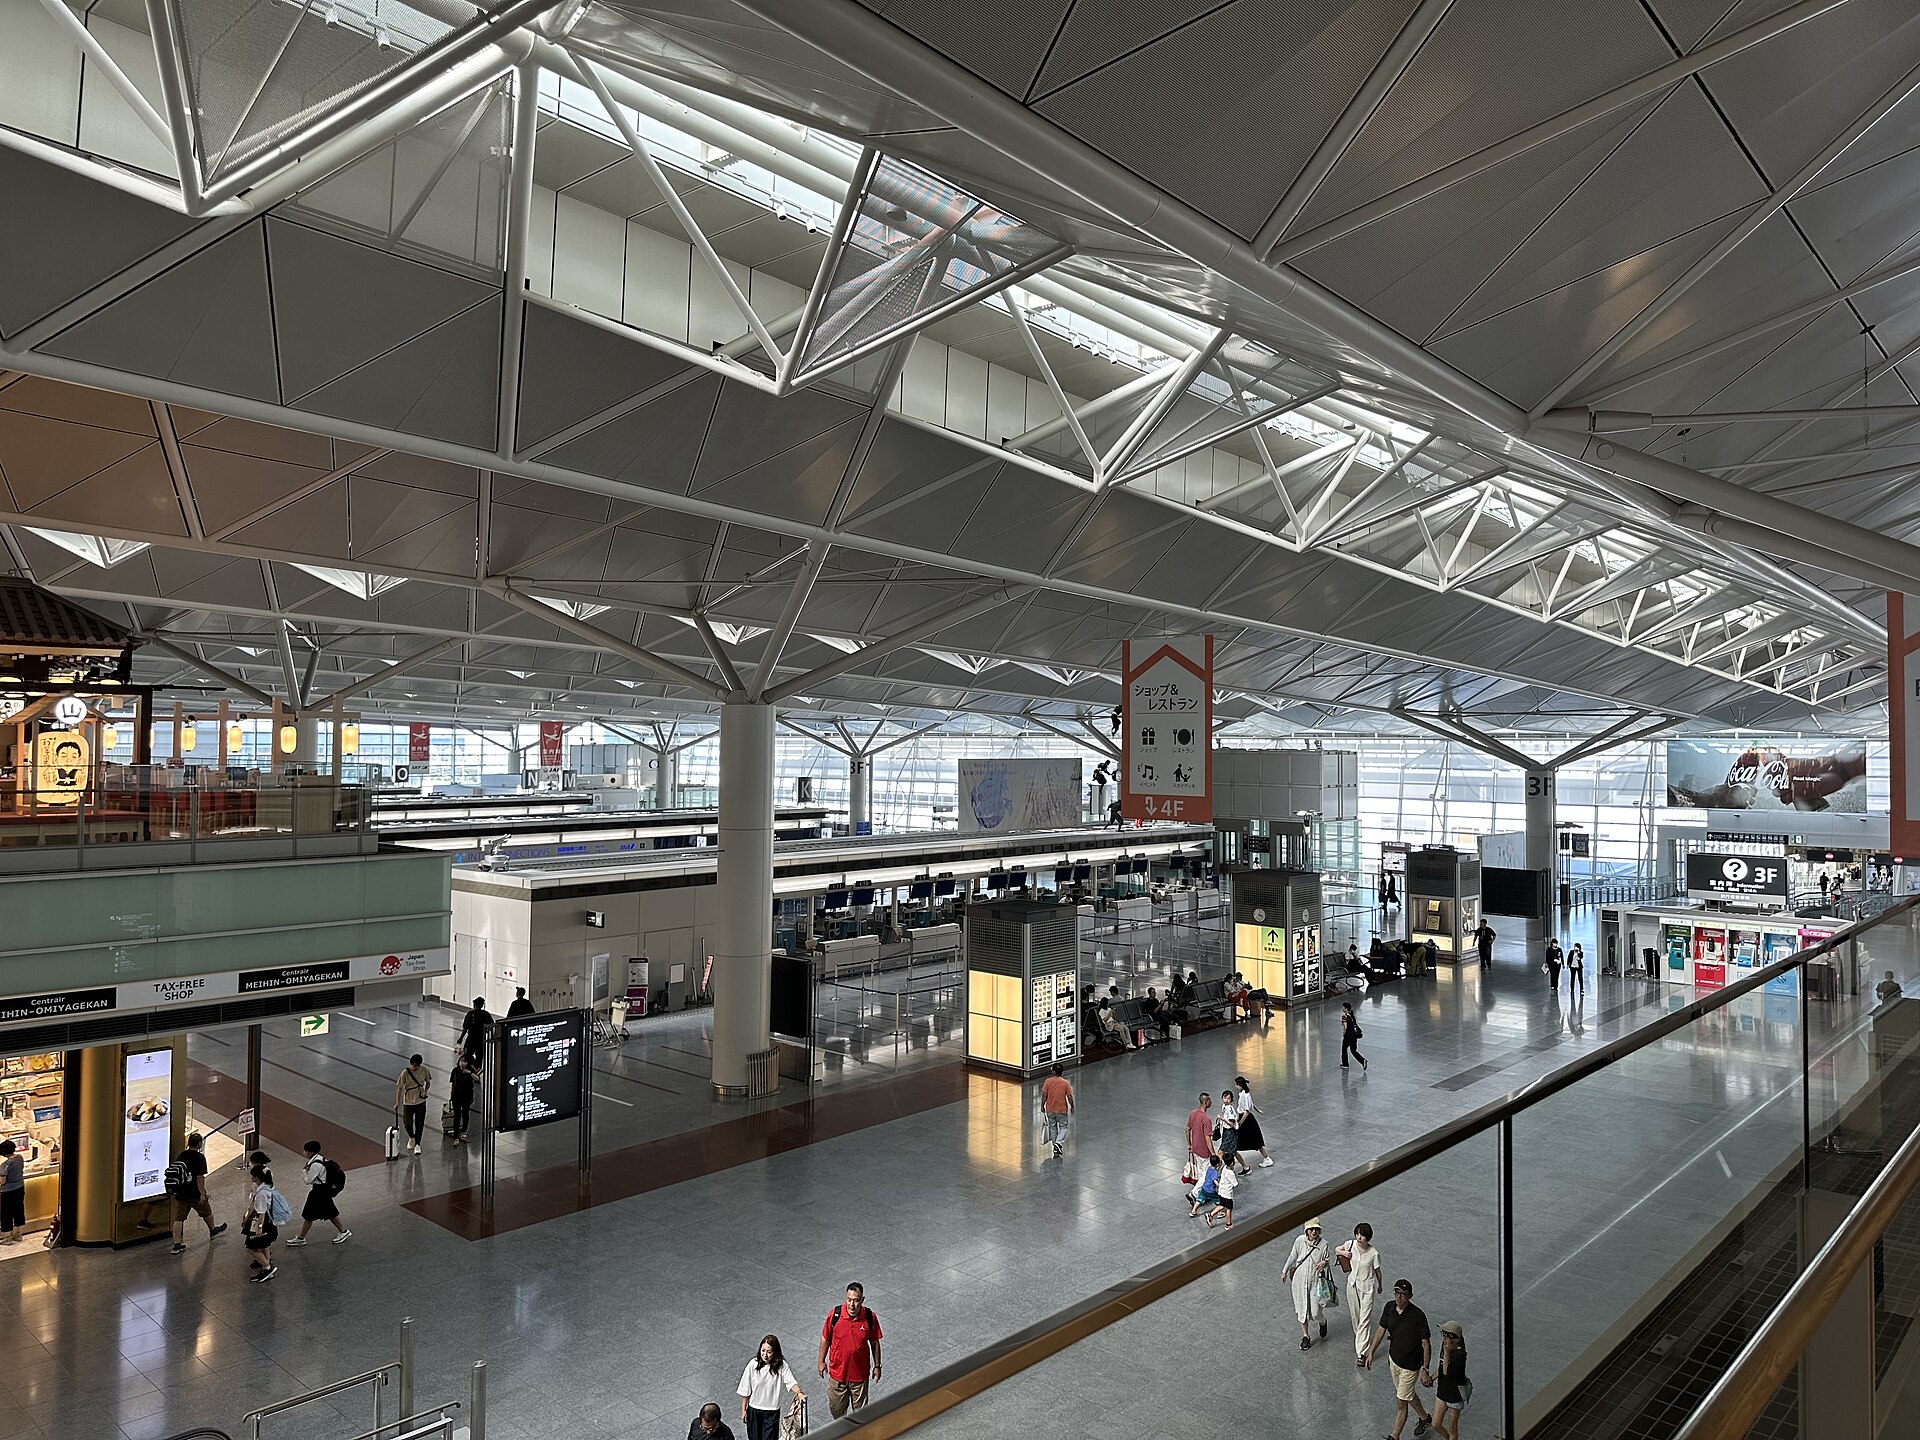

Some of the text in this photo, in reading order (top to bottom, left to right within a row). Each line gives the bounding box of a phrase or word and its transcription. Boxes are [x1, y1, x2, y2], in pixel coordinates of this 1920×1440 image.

[1134, 683, 1179, 697] ショップ&
[1148, 698, 1199, 711] レストラン
[527, 771, 539, 786] N
[564, 773, 576, 787] M
[801, 781, 810, 798] K
[1528, 776, 1552, 796] 3F
[1160, 799, 1184, 817] 4F
[1754, 867, 1778, 883] 3F
[281, 968, 310, 977] Centrair
[153, 979, 205, 993] TAX-FREE
[245, 971, 343, 989] MEIHIN-OMIYAGEKAN
[30, 996, 66, 1006] Centrair
[164, 990, 194, 1001] SHOP
[240, 1115, 253, 1125] 入口
